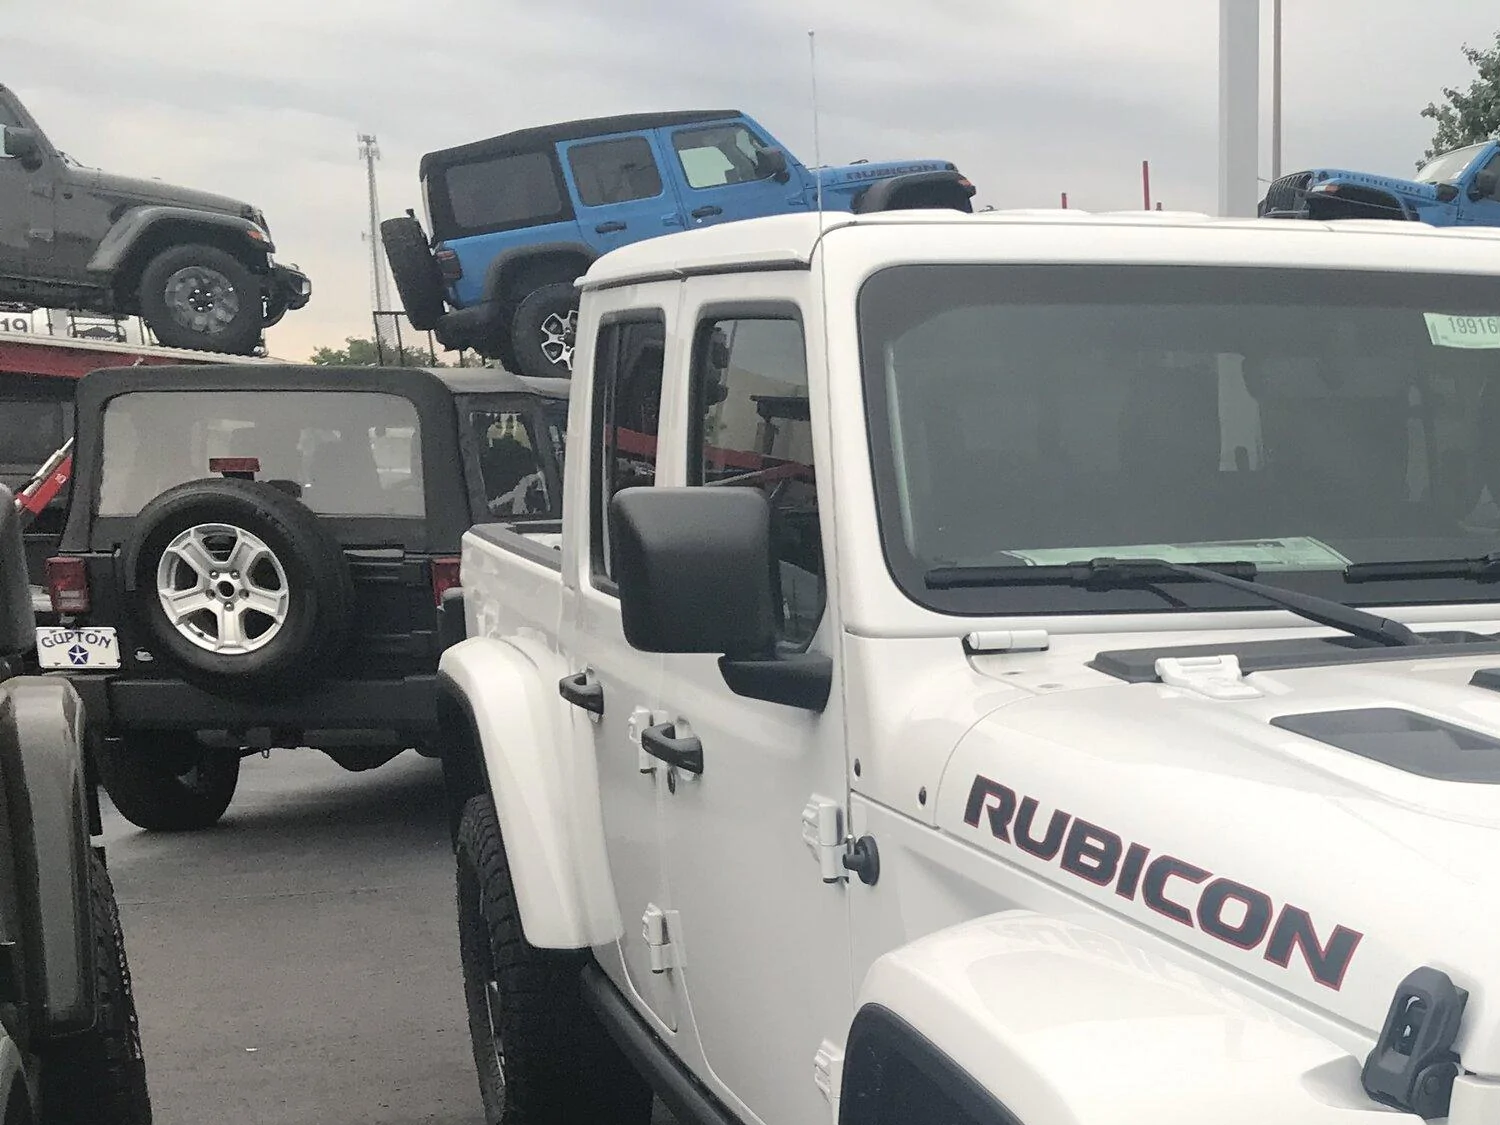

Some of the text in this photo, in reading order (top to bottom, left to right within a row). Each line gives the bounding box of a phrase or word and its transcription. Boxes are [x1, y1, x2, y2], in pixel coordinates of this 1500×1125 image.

[1448, 317, 1498, 334] 19916
[41, 631, 112, 648] GUPTON
[964, 774, 1363, 992] RUBICON
